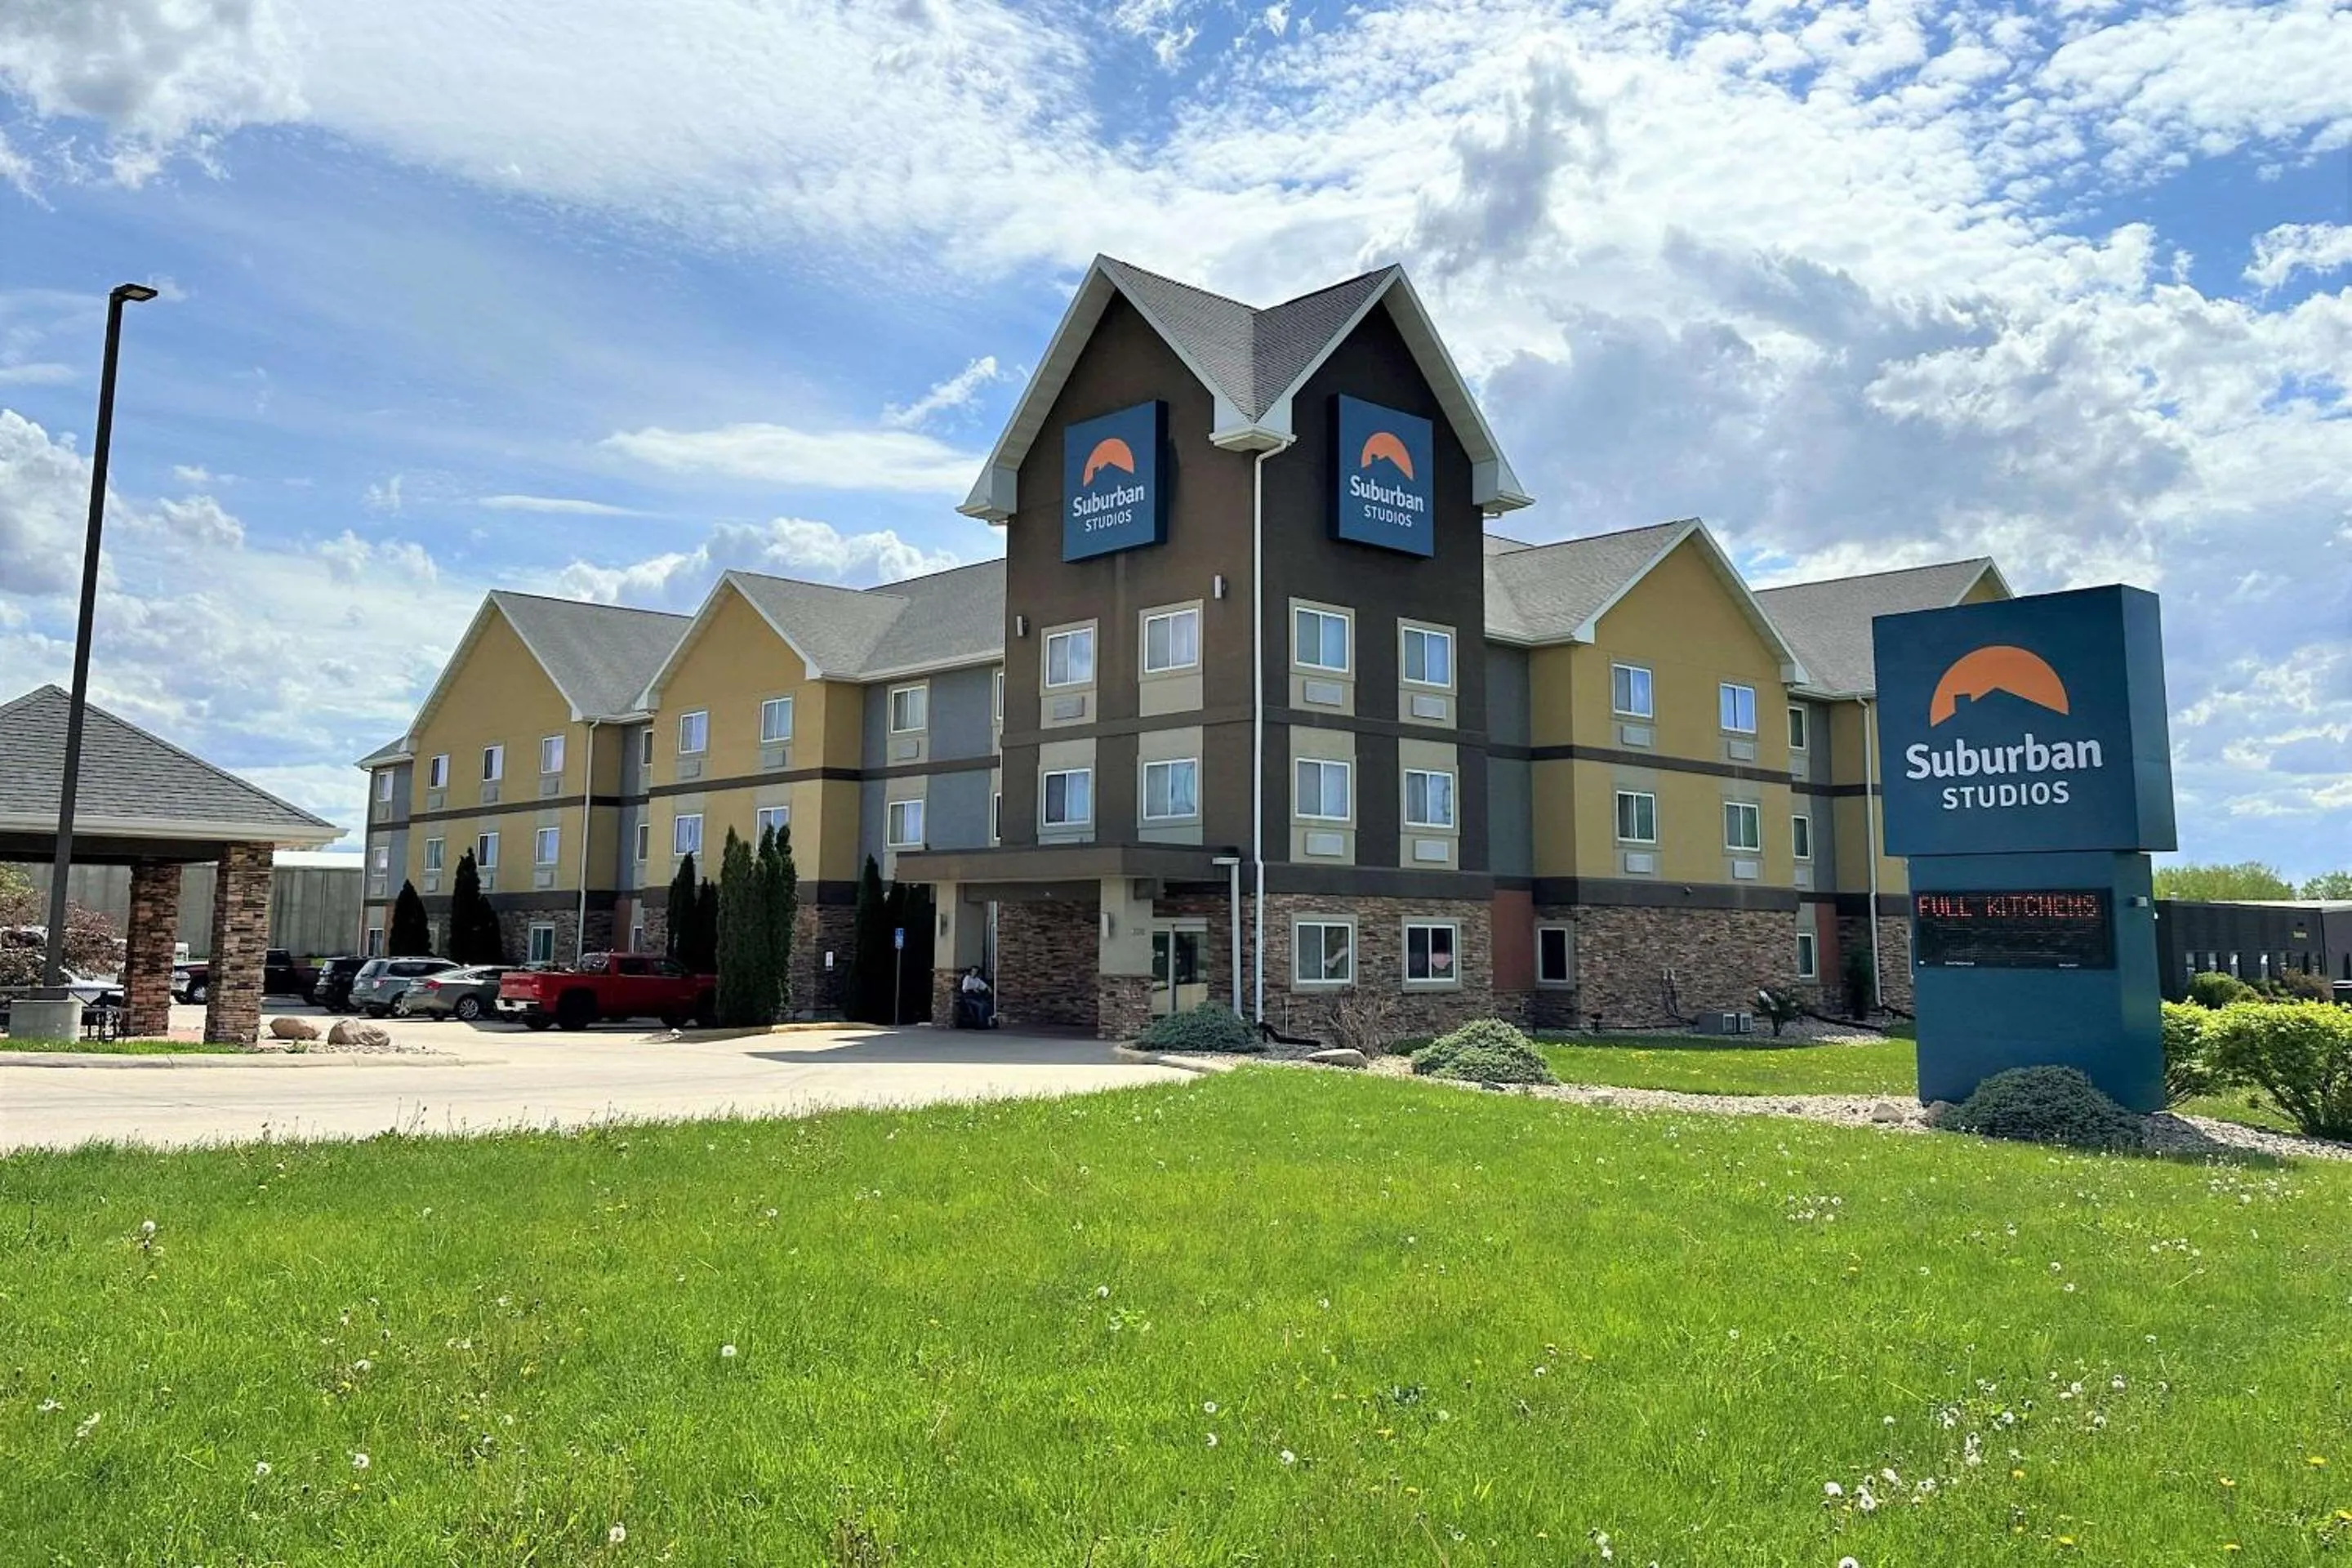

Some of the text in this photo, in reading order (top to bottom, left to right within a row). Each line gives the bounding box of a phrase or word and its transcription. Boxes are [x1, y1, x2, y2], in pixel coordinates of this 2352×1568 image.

[1072, 485, 1144, 517] Suburban
[1350, 475, 1424, 513] Suburban
[1085, 509, 1132, 532] STUDIOS
[1364, 504, 1412, 528] STUDIOS
[1905, 733, 2103, 780] Suburban
[1942, 781, 2069, 809] STUDIOS
[1918, 896, 1973, 917] FULL
